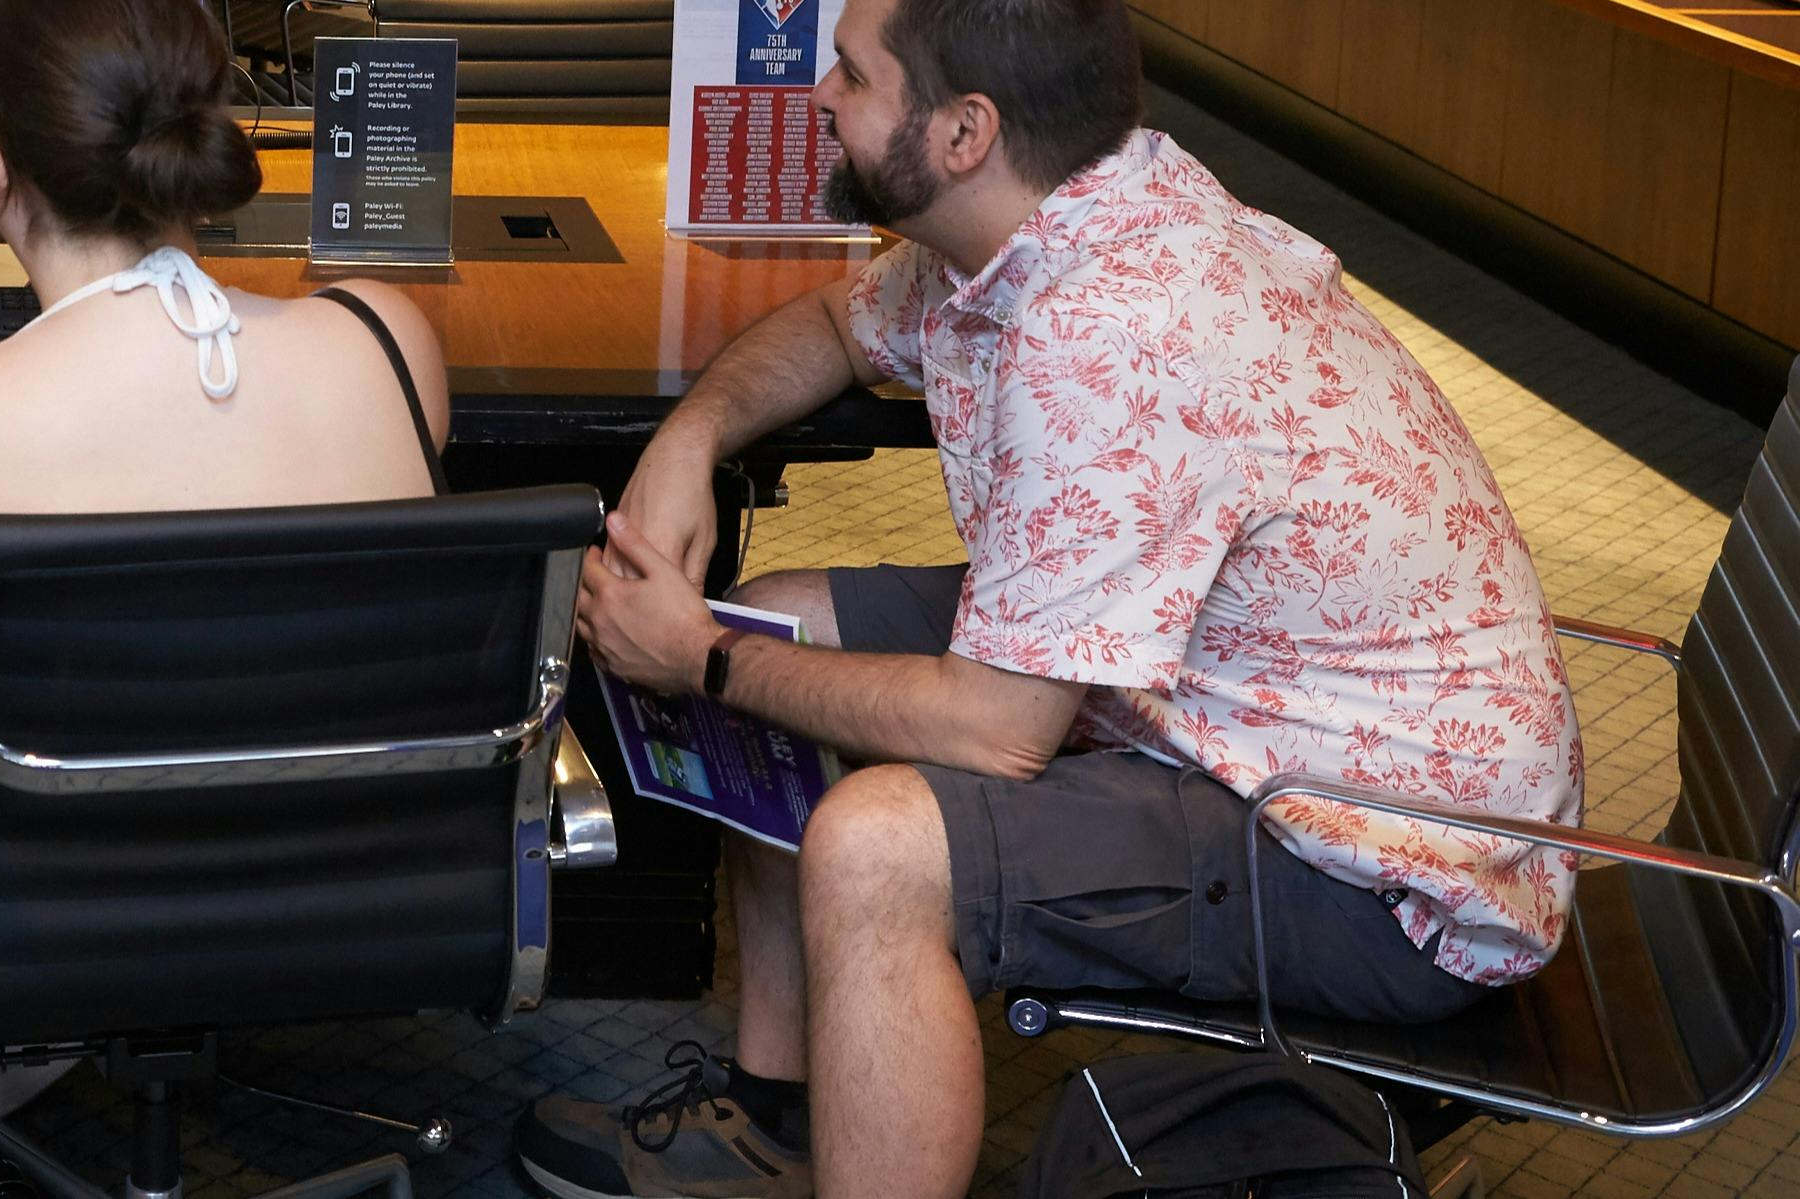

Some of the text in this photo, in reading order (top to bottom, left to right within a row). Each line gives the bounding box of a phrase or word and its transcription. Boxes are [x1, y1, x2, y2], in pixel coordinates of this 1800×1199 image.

[767, 34, 787, 47] 75TH
[750, 48, 802, 62] ANNIVERSARY
[369, 61, 415, 69] Please silence
[766, 62, 785, 75] TEAM
[369, 72, 383, 80] your
[385, 71, 406, 80] phone
[408, 71, 423, 79] (and
[379, 81, 396, 90] quiet
[406, 81, 432, 89] vibrate)
[387, 102, 413, 110] Library.
[368, 124, 401, 133] Recording
[367, 135, 416, 143] photographing
[366, 155, 384, 163] Paley
[366, 165, 427, 173] strictly prohibited.
[365, 202, 383, 210] Paley
